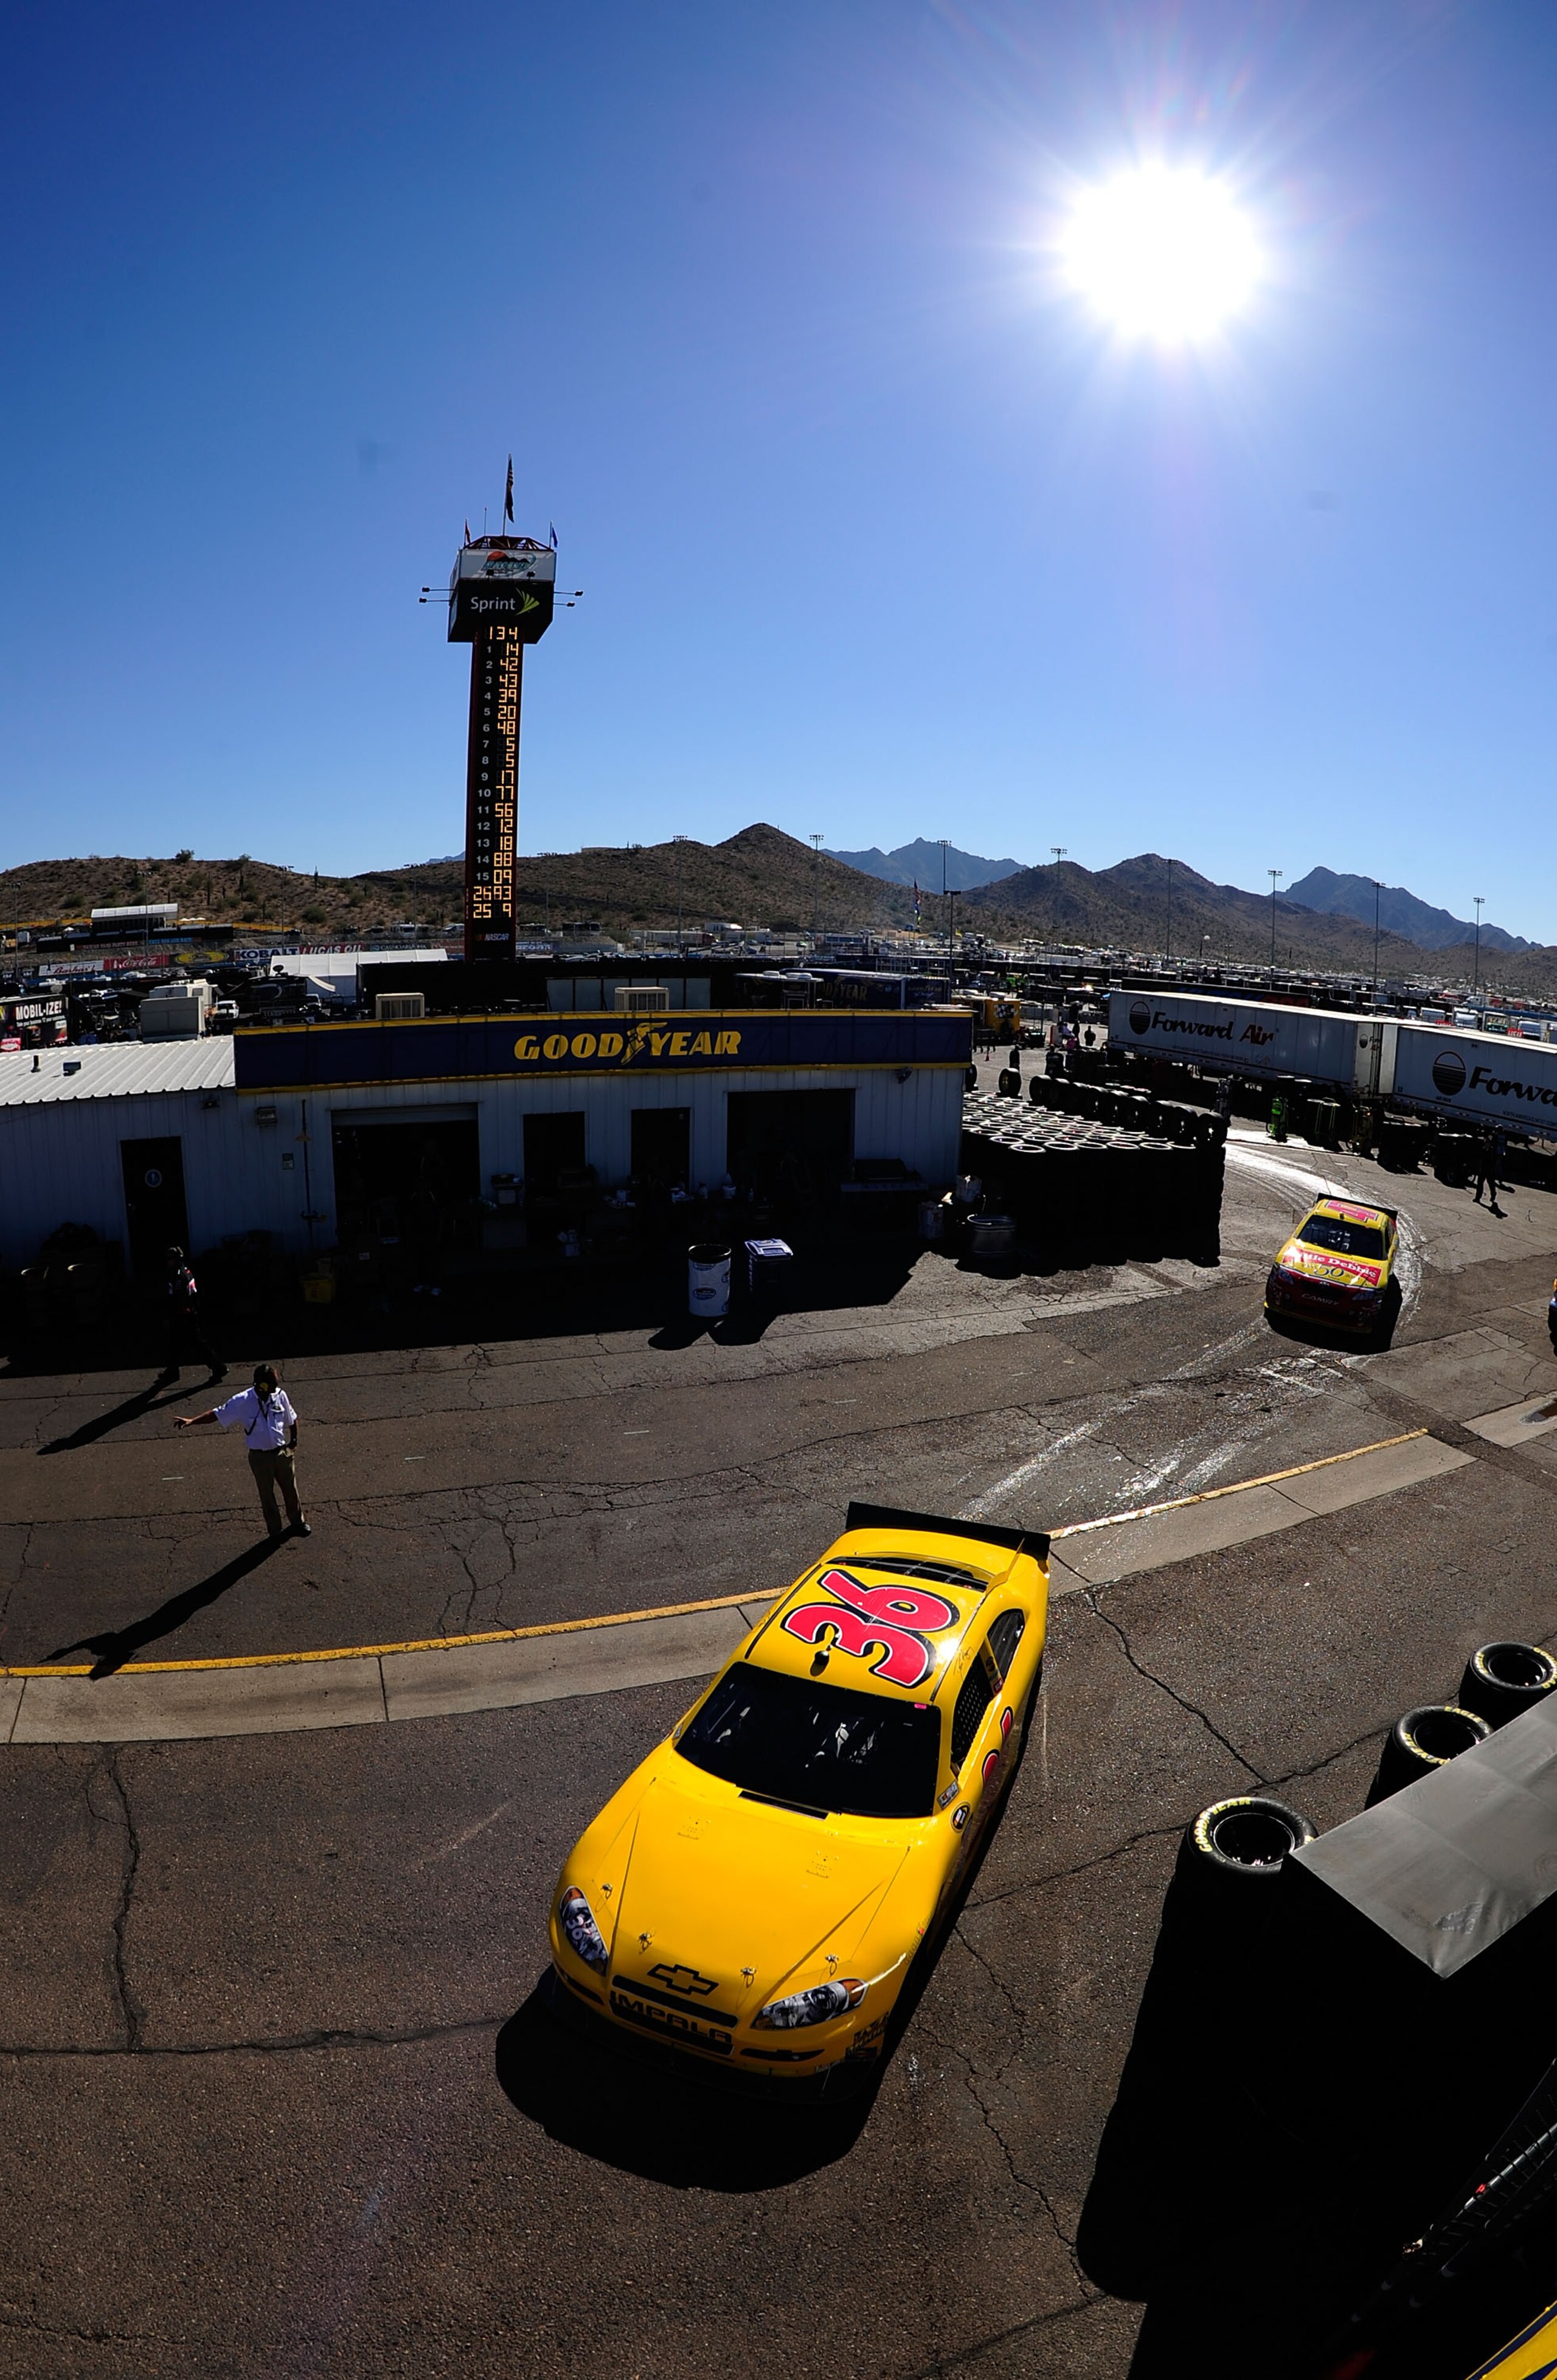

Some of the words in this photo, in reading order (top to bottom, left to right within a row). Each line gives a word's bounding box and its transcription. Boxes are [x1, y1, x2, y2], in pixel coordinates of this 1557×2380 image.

[471, 596, 516, 613] Sprint
[489, 626, 518, 639] 134
[506, 642, 519, 656] 14
[501, 658, 518, 671] 42
[499, 673, 517, 687] 43
[498, 689, 517, 703] 39
[498, 705, 516, 719] 20
[498, 720, 515, 734] 48
[506, 737, 515, 751] 5
[482, 756, 489, 764] 8
[505, 753, 515, 767] 5
[481, 772, 488, 781] 9
[501, 770, 514, 784] 17
[478, 788, 491, 798] 10
[496, 785, 514, 800] 77
[495, 803, 513, 817] 56
[476, 822, 490, 830] 12
[500, 819, 513, 833] 12
[476, 839, 490, 847] 13
[499, 836, 513, 851] 18
[476, 855, 490, 864] 14
[494, 852, 513, 867] 88
[476, 872, 490, 881] 15
[493, 869, 512, 884] 09
[473, 903, 492, 918] 25
[502, 903, 511, 917] 9
[235, 947, 299, 959] KOBALT
[1151, 1011, 1234, 1040] Forward
[1239, 1024, 1274, 1045] Air
[1314, 1265, 1344, 1277] 50
[1327, 1258, 1377, 1278] Debbie
[1301, 1293, 1339, 1306] CAMRY
[780, 1568, 960, 1689] 36
[1444, 1705, 1482, 1724] EAGLE
[1194, 1797, 1252, 1853] GOODYEAR
[609, 1991, 732, 2045] IMPALA
